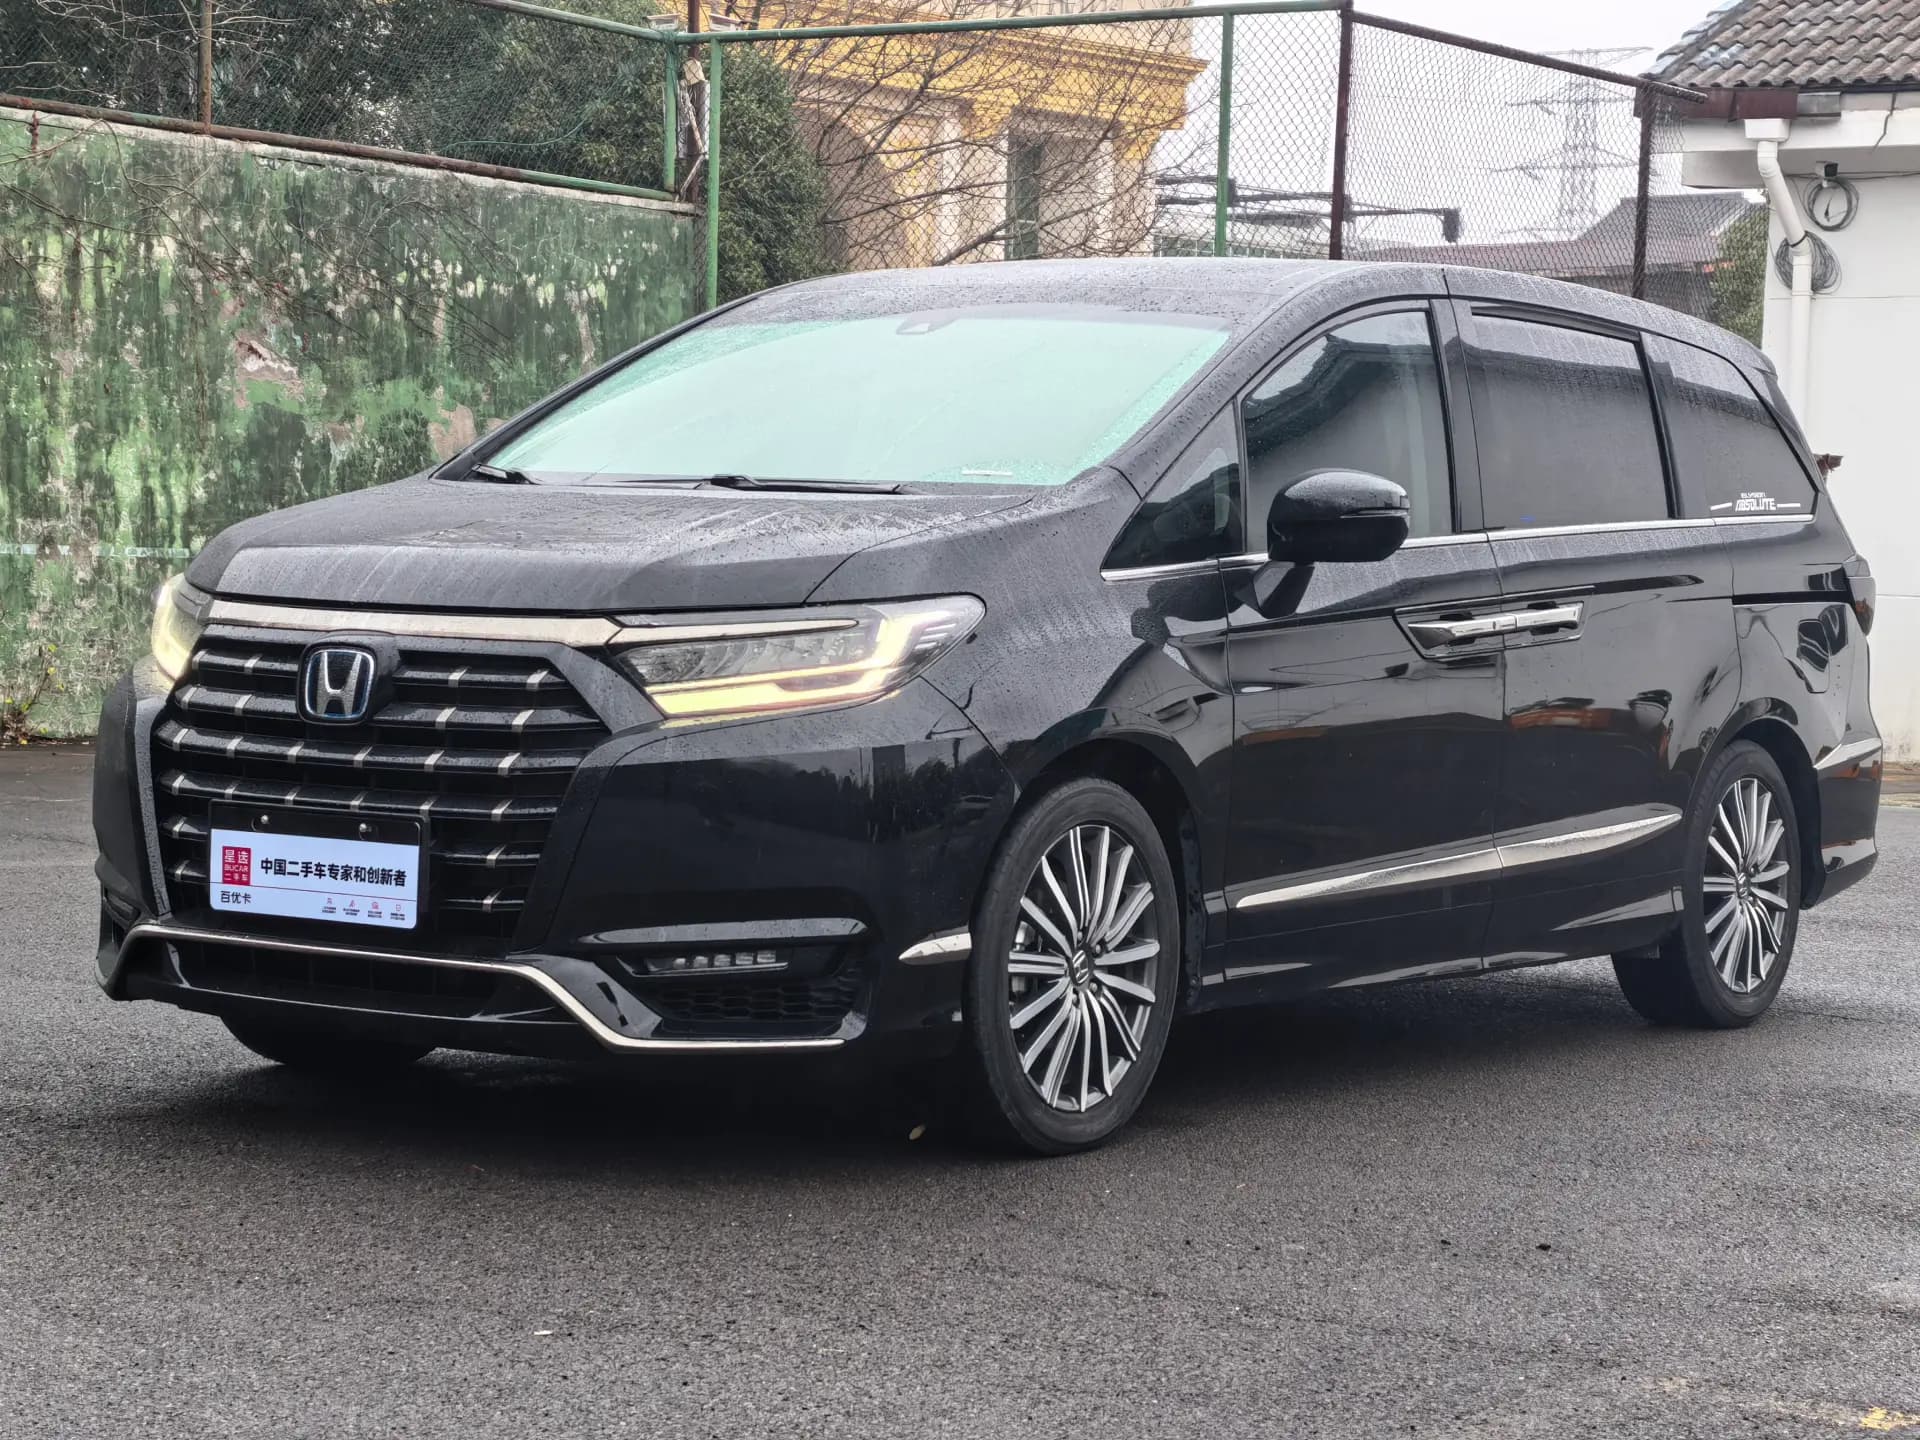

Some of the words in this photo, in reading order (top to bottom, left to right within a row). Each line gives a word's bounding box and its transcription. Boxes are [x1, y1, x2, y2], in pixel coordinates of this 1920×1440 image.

[1735, 497, 1777, 512] ABSOLUTE
[260, 857, 408, 887] 中国二手车专家和创新者
[220, 890, 252, 904] 百优卡
